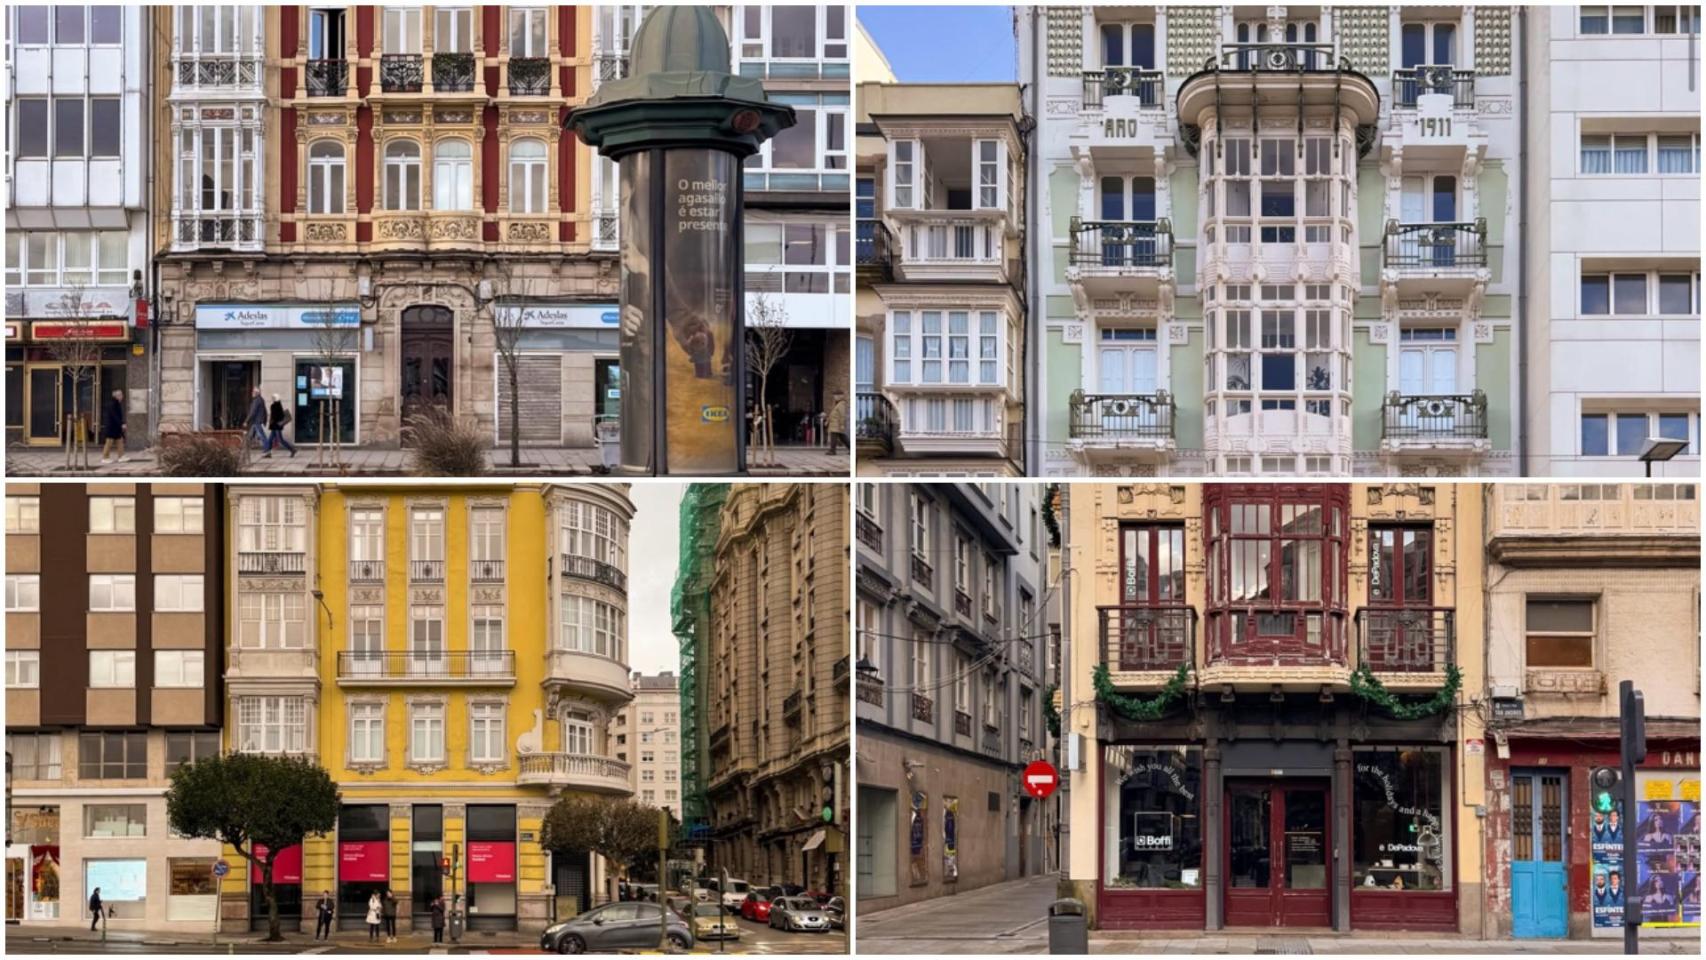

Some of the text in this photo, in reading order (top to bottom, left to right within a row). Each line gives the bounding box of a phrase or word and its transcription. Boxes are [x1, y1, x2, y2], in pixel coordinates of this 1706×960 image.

[1419, 118, 1451, 137] 1911
[678, 179, 689, 191] O
[678, 205, 720, 217] é estar
[237, 311, 268, 320] Adeslas
[1147, 763, 1162, 773] you
[1163, 765, 1175, 775] all
[1171, 773, 1181, 787] the
[1179, 785, 1194, 800] best
[1357, 763, 1369, 772] for
[1371, 765, 1384, 777] the
[1399, 806, 1415, 815] and
[1147, 835, 1171, 846] Boffi
